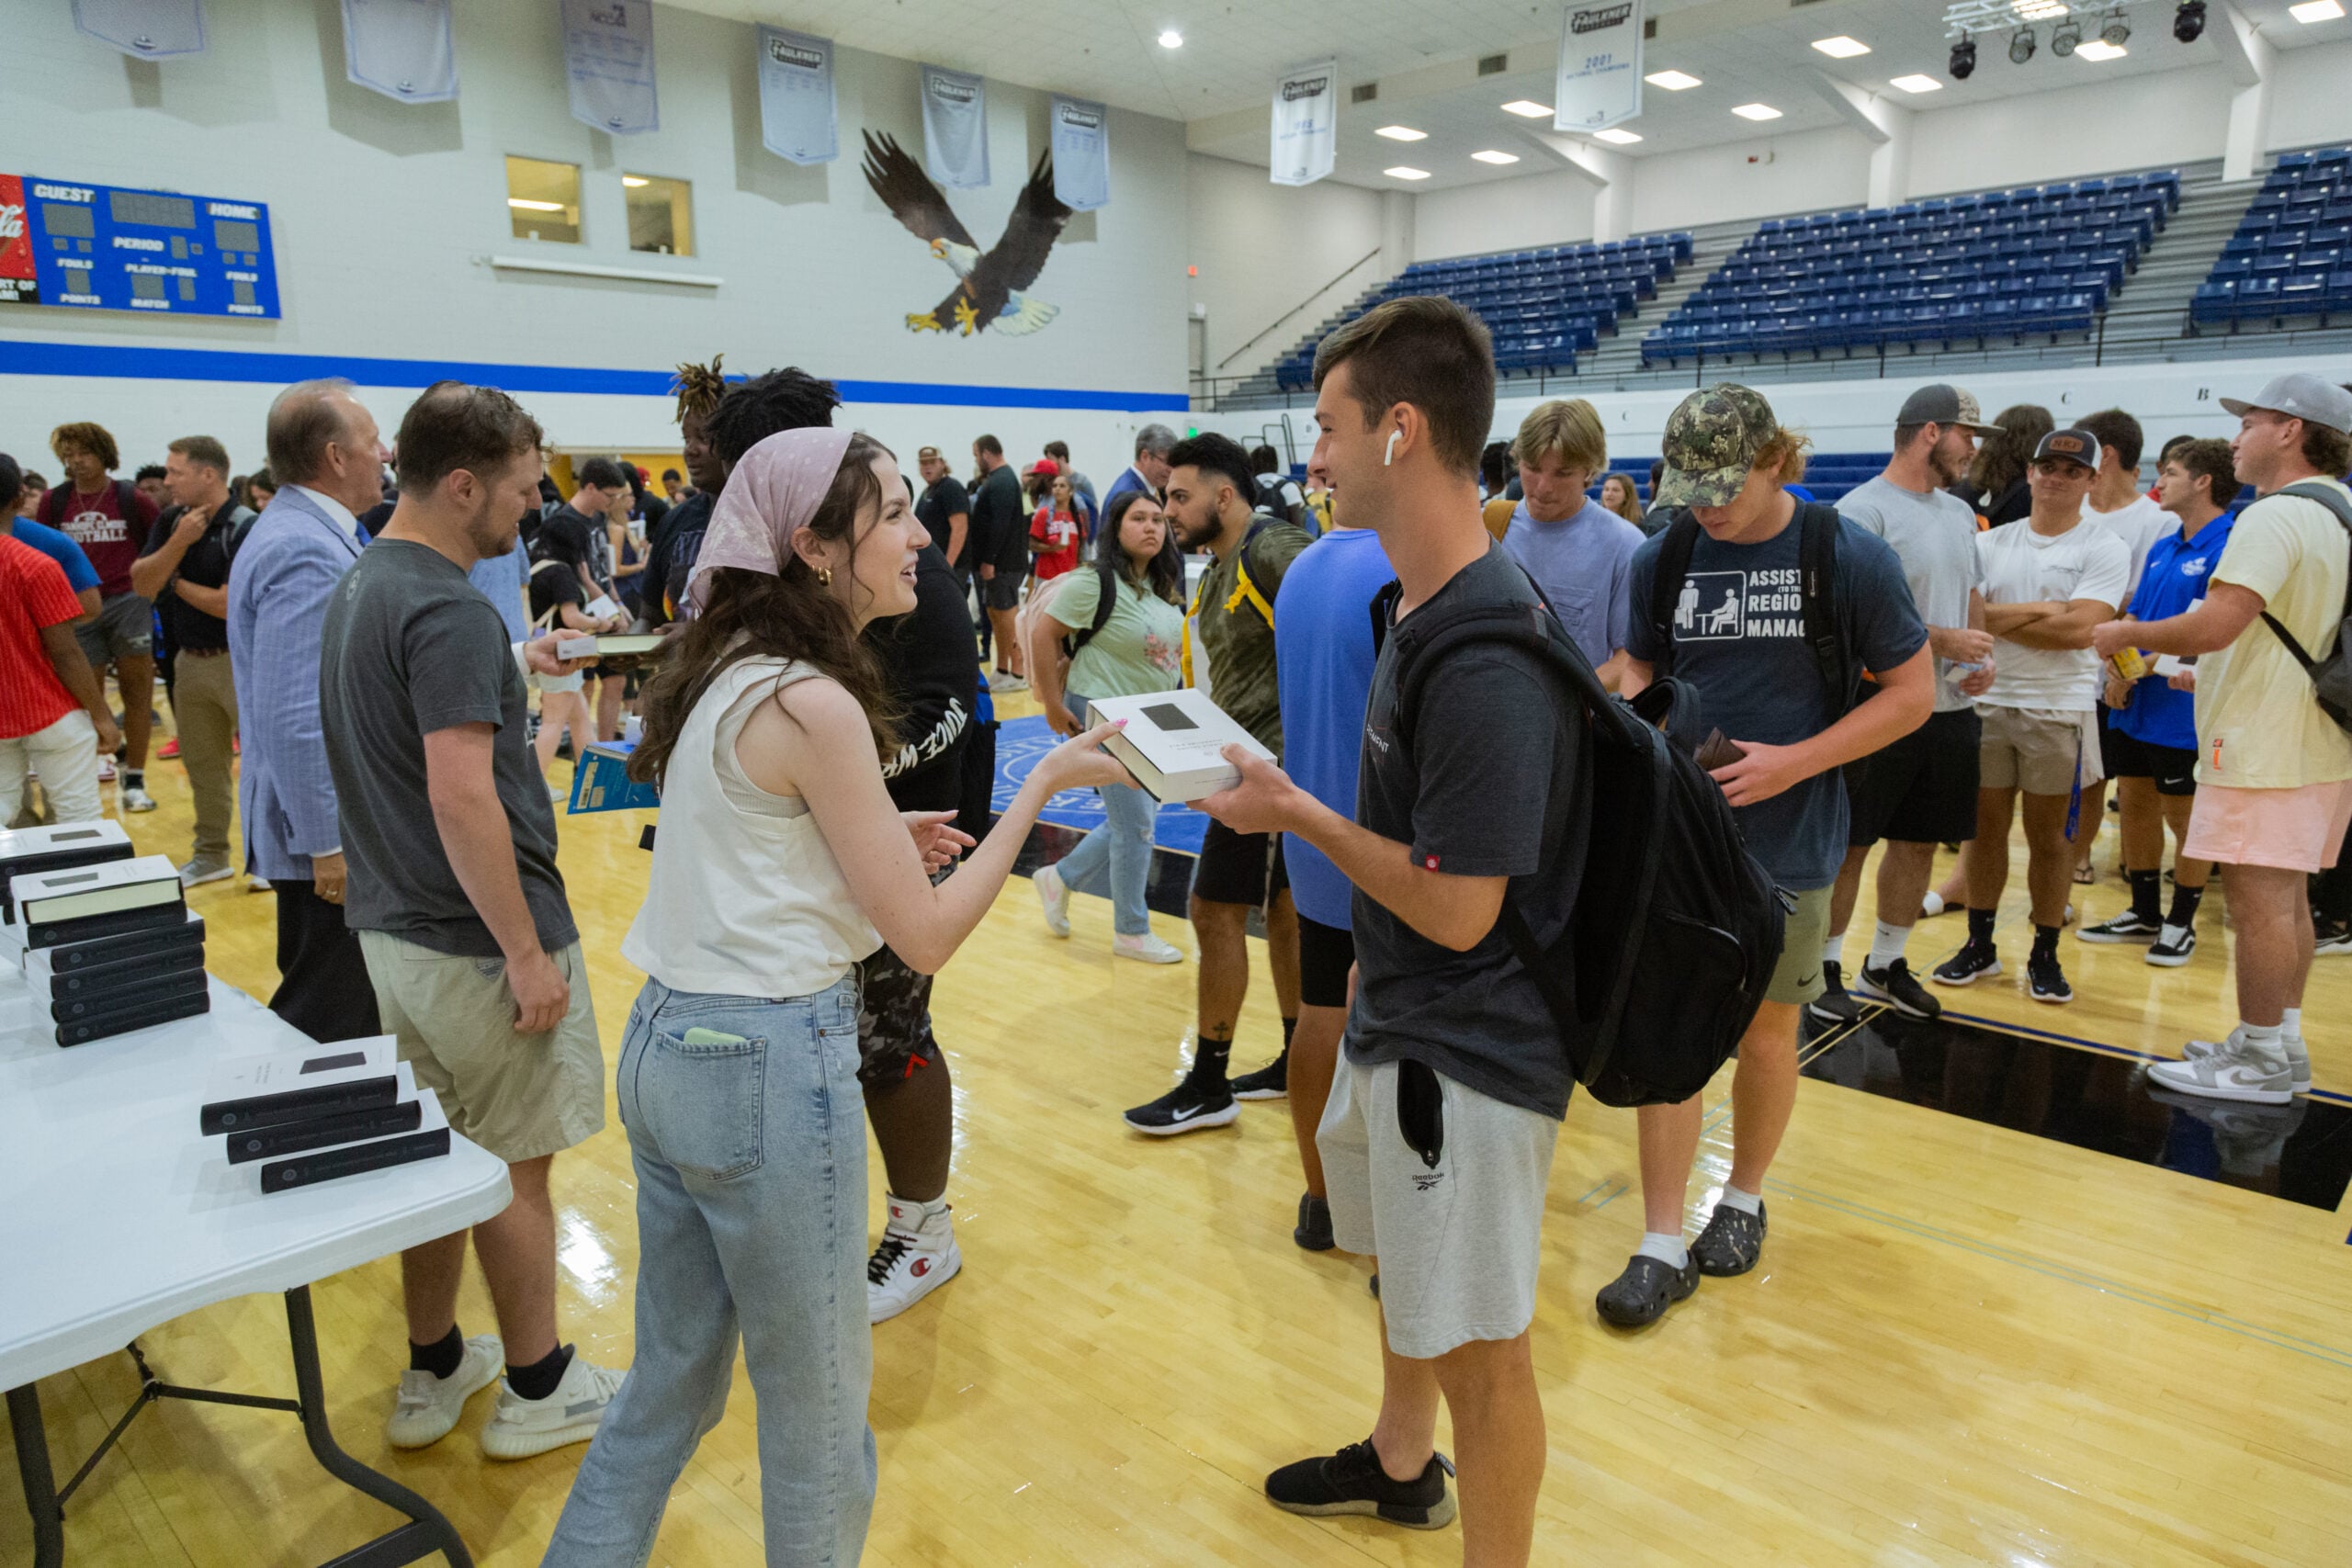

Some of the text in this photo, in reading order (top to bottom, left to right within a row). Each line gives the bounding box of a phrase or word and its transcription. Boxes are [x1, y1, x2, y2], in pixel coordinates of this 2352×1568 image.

[34, 184, 96, 203] GUEST
[209, 203, 258, 220] HOME
[113, 236, 164, 252] PERIOD
[56, 258, 94, 270] FOULS
[225, 270, 258, 283] FOULS
[17, 279, 37, 291] OF
[60, 293, 101, 305] POINTS
[130, 298, 170, 309] MATCH
[227, 303, 264, 315] POINTS
[2197, 388, 2210, 401] B
[1748, 593, 1802, 613] REGIO
[917, 697, 968, 762] JUICE
[1412, 1172, 1444, 1181] Reebok
